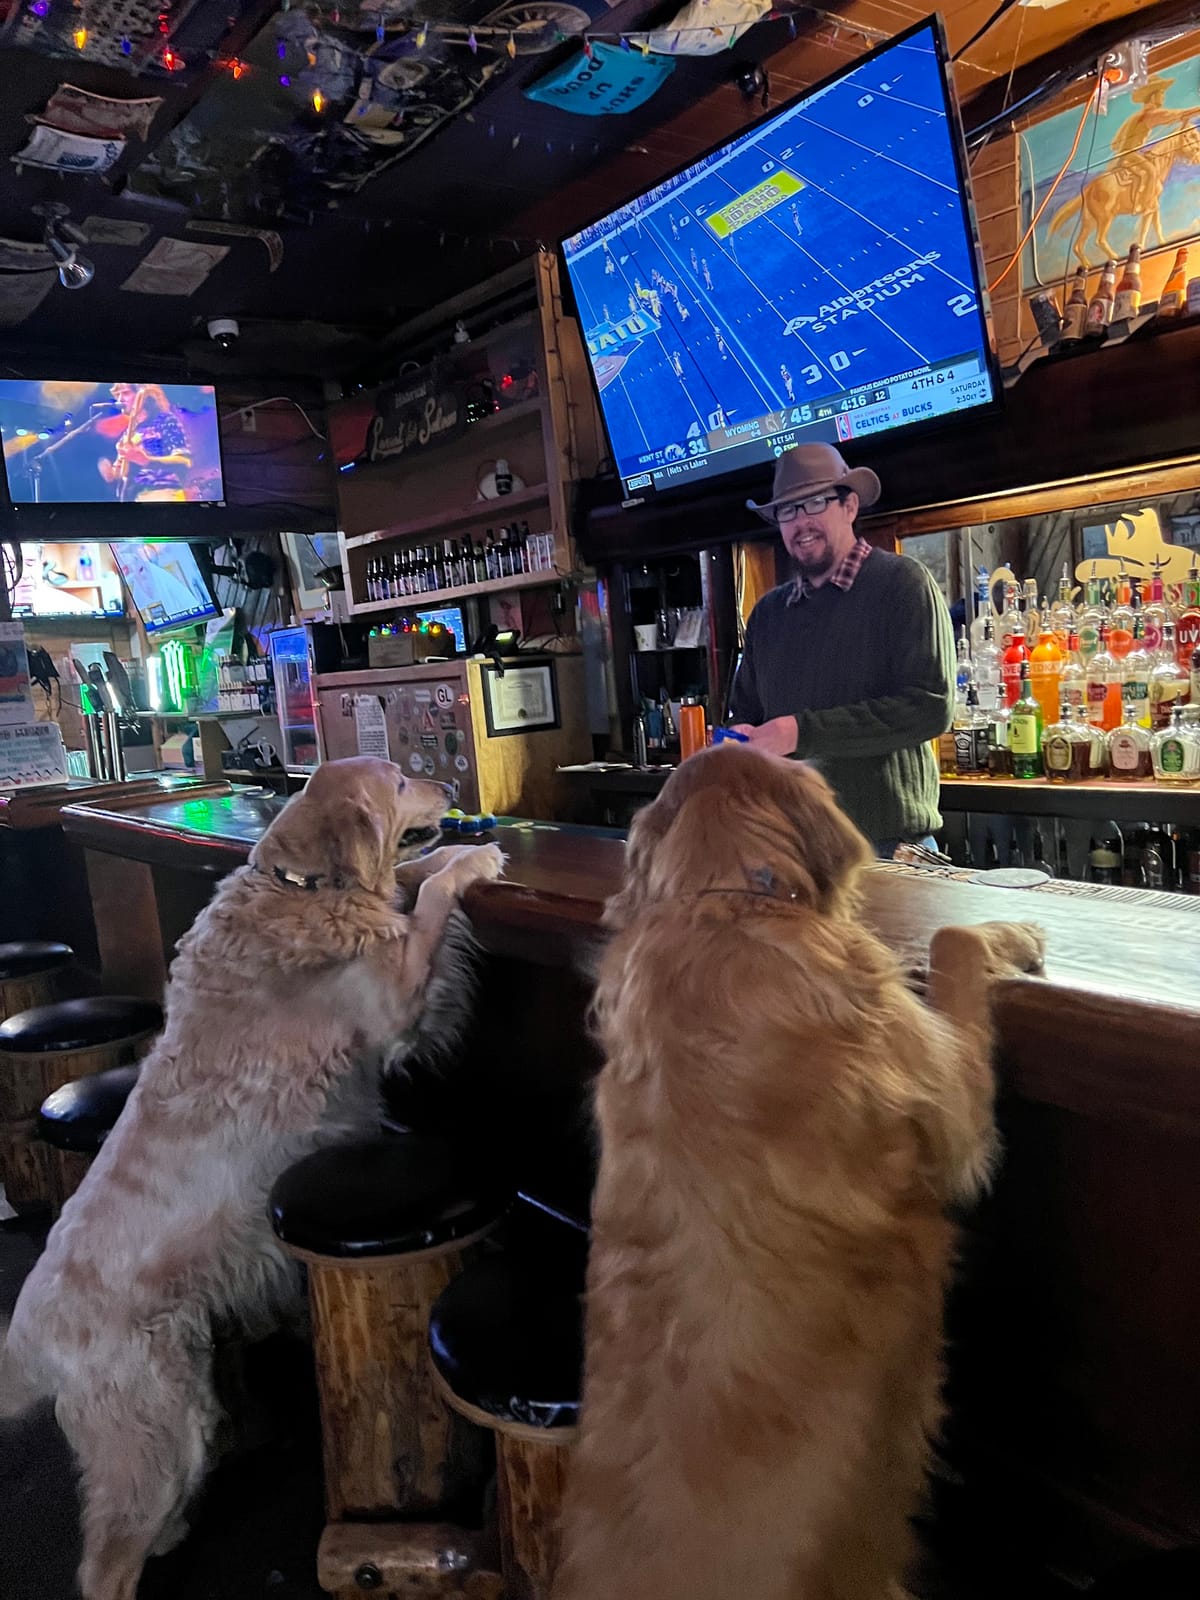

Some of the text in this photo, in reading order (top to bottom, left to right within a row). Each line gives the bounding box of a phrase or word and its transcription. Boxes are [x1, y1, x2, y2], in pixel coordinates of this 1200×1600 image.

[588, 82, 613, 100] UP
[725, 187, 782, 225] IDAHO
[819, 250, 942, 318] Albertsons
[812, 273, 925, 333] STADIUM
[890, 371, 913, 384] POTATO
[913, 366, 932, 378] BOWL
[911, 370, 956, 391] 4TH & 4
[950, 378, 987, 395] SATURDAY
[818, 391, 886, 418] 4TH 4:16 12
[790, 405, 813, 424] 45
[855, 413, 890, 430] CELTICS
[902, 401, 933, 418] BUCKS
[725, 421, 760, 438] WYOMING
[655, 450, 663, 459] ST
[688, 438, 707, 455] 31
[1179, 629, 1199, 644] UV
[437, 688, 452, 703] GL
